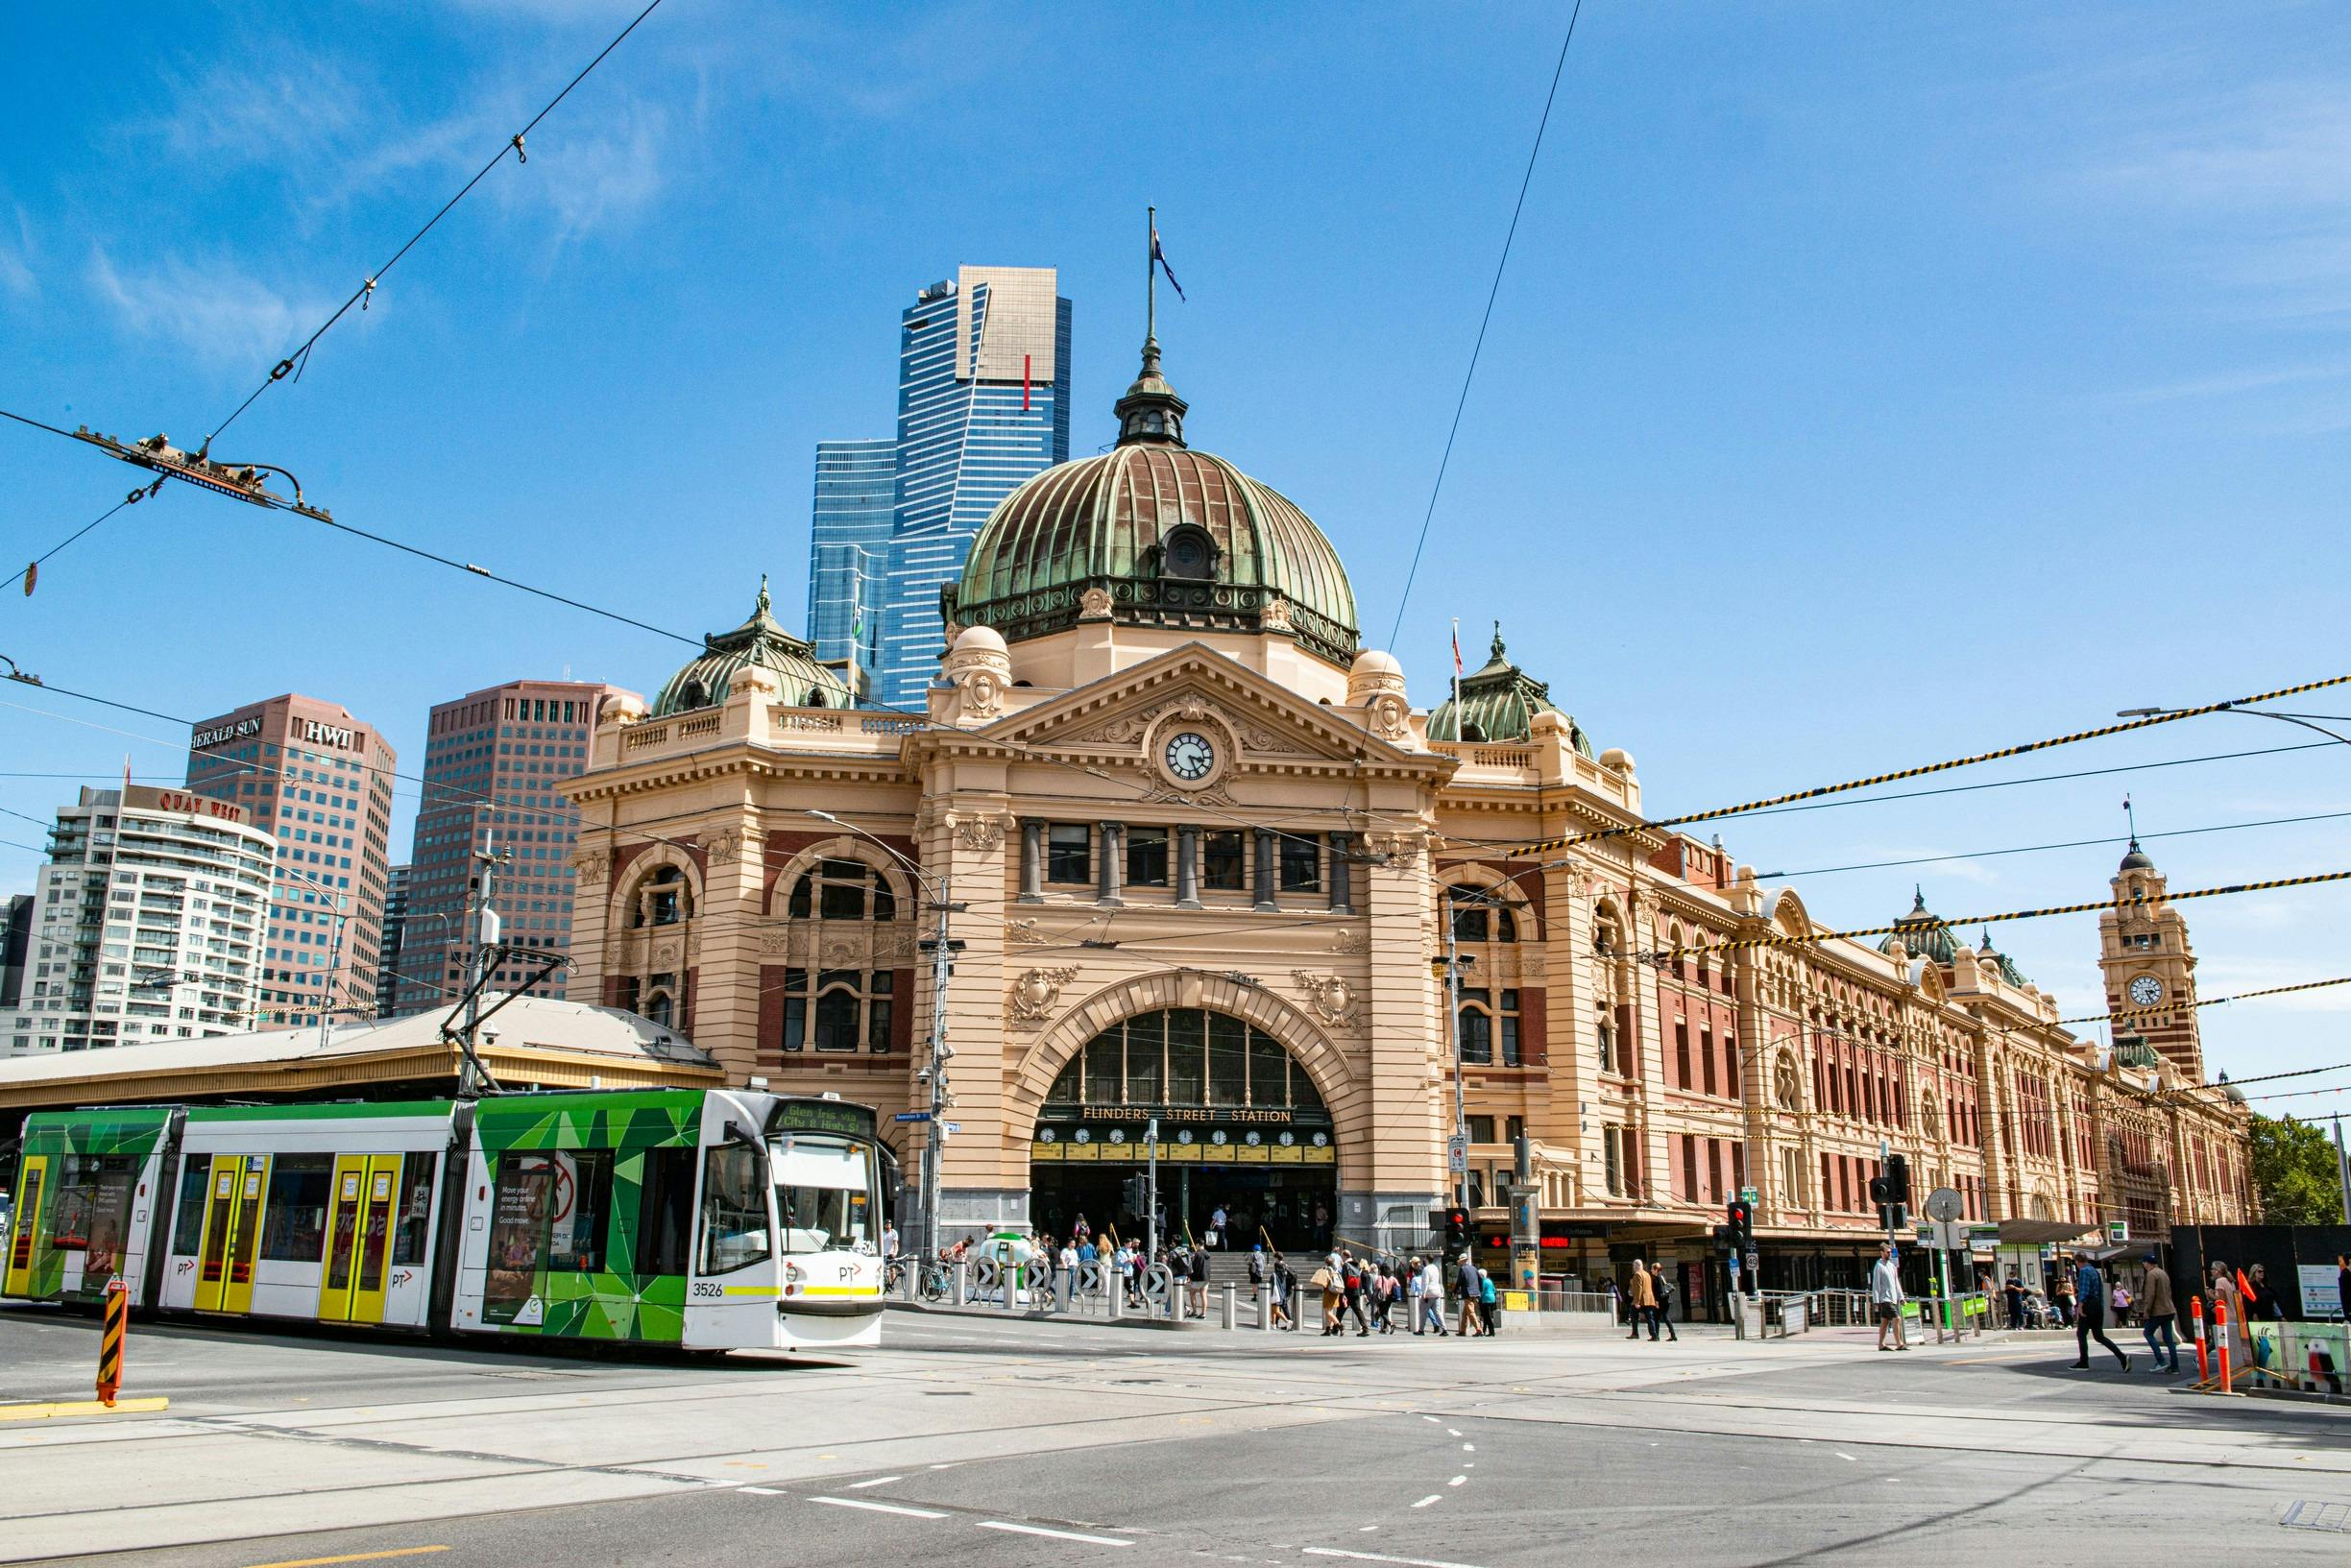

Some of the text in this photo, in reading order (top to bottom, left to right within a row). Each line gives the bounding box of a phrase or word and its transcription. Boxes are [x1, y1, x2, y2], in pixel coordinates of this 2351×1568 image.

[191, 717, 261, 749] HERALD SUN
[306, 721, 352, 748] HWT
[160, 793, 241, 823] QUAY WEST
[788, 1105, 858, 1122] Glen Iris via
[1082, 1107, 1292, 1122] FLINDERS STREET STATION
[784, 1116, 806, 1128] City
[821, 1120, 844, 1131] High
[518, 1187, 530, 1195] your
[499, 1216, 515, 1224] Good
[692, 1282, 723, 1297] 3526
